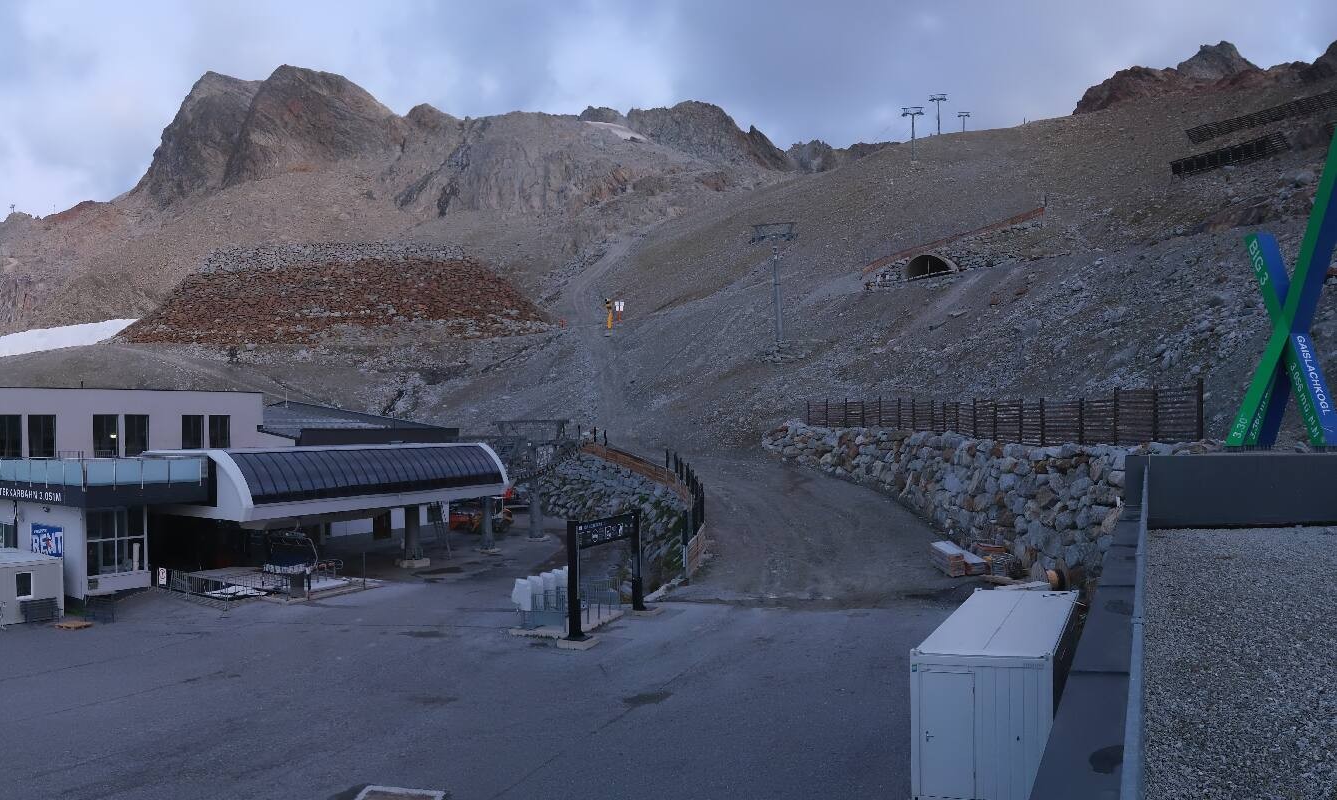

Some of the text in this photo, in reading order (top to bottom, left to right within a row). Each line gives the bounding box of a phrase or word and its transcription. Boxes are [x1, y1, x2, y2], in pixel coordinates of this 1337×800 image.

[1249, 239, 1269, 286] BIG 3
[1296, 335, 1331, 416] GAISLACHKOGL
[32, 531, 63, 555] RENT
